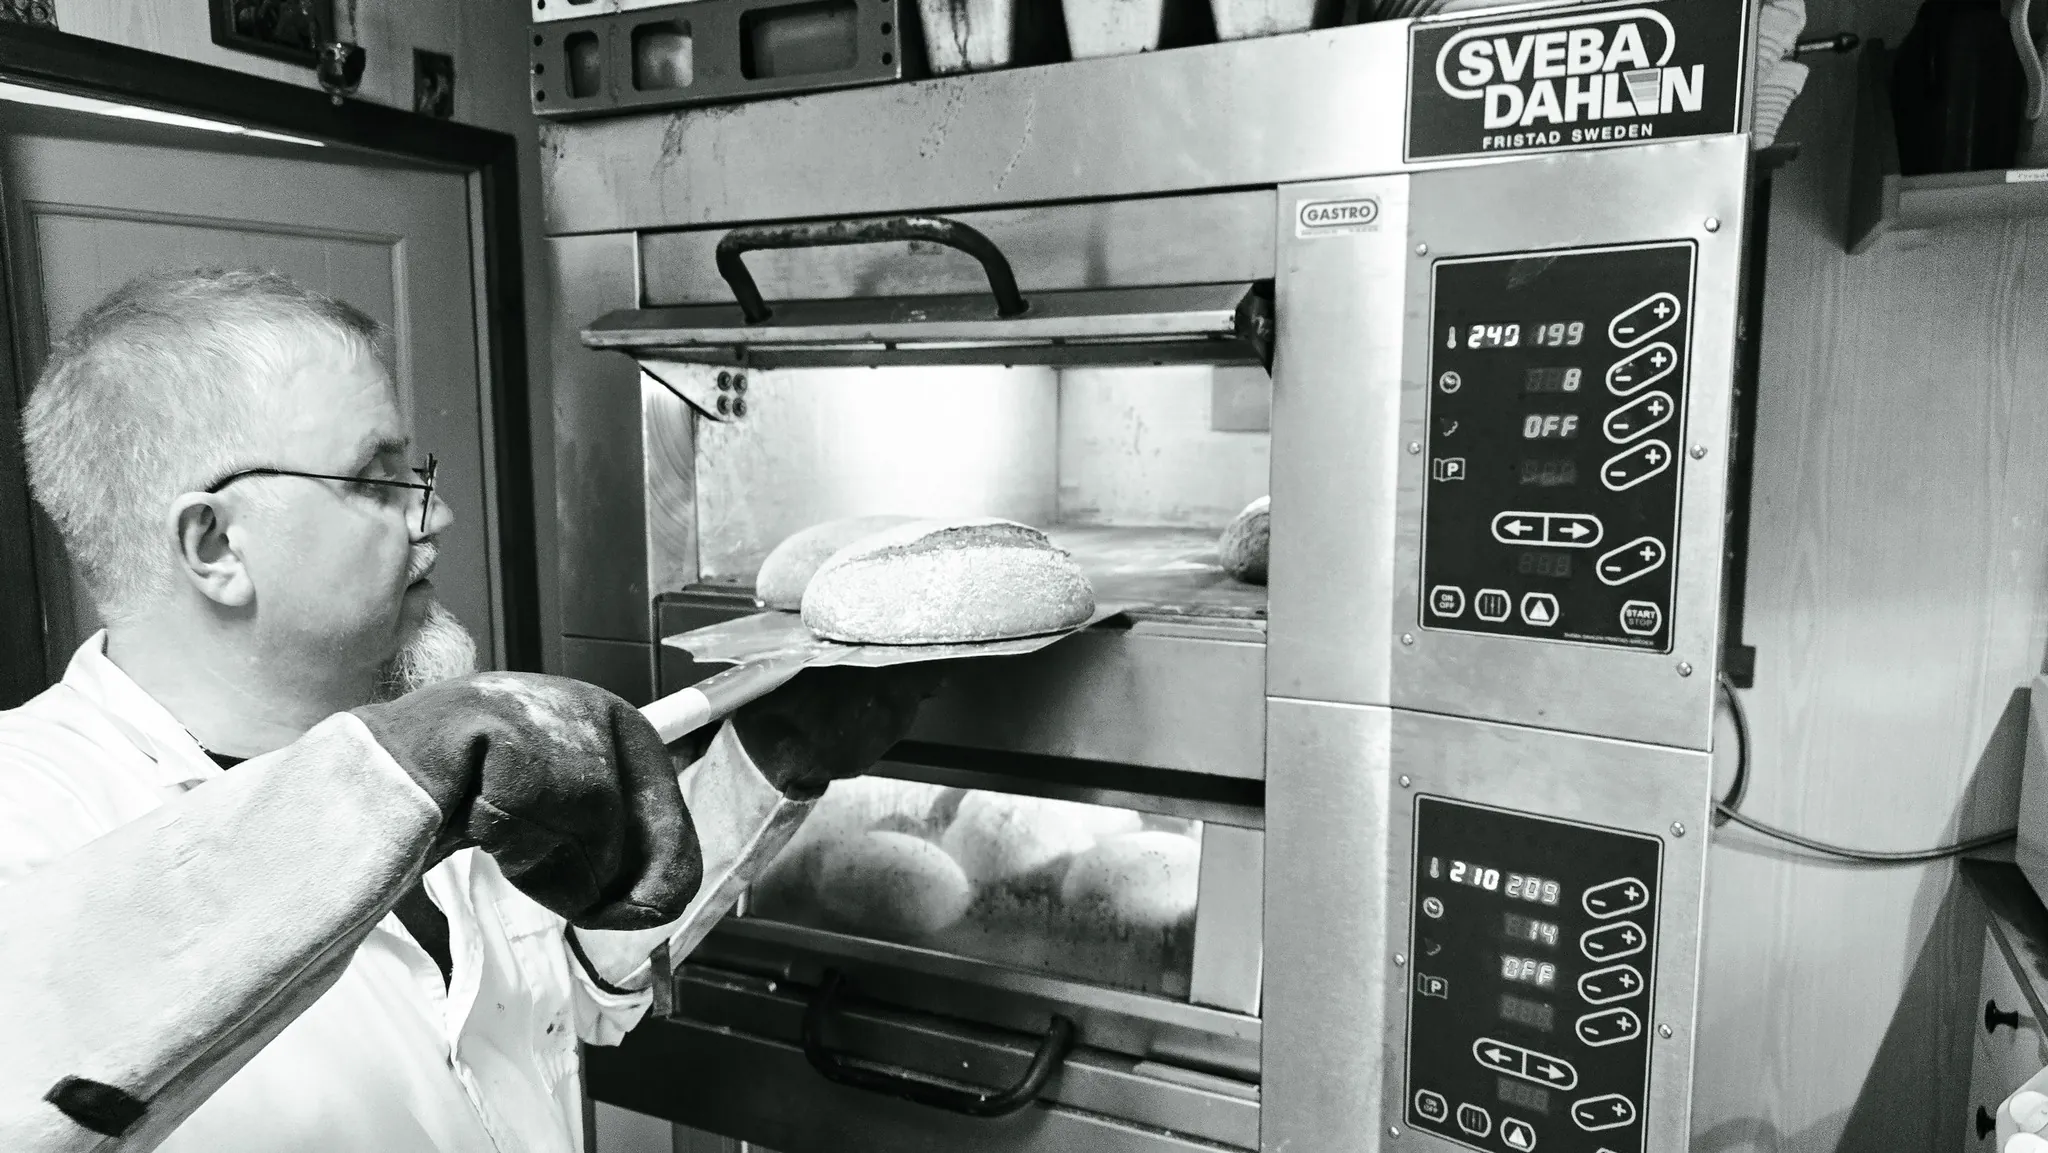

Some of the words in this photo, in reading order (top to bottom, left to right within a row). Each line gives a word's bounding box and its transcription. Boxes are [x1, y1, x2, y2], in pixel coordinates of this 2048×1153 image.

[1457, 22, 1650, 87] SVEBA
[1482, 131, 1561, 150] FRISTAD
[1571, 123, 1653, 143] SWEDEN
[1307, 205, 1371, 221] GASTRO
[1467, 324, 1520, 348] 240
[1537, 322, 1584, 346] 199
[1562, 368, 1582, 391] 8
[1523, 415, 1579, 438] OFF
[1447, 462, 1459, 476] P
[1626, 609, 1656, 619] START
[1628, 618, 1653, 627] STOP
[1449, 861, 1500, 891] 210
[1505, 874, 1560, 905] 209
[1529, 921, 1559, 945] 14
[1503, 956, 1555, 985] OFF
